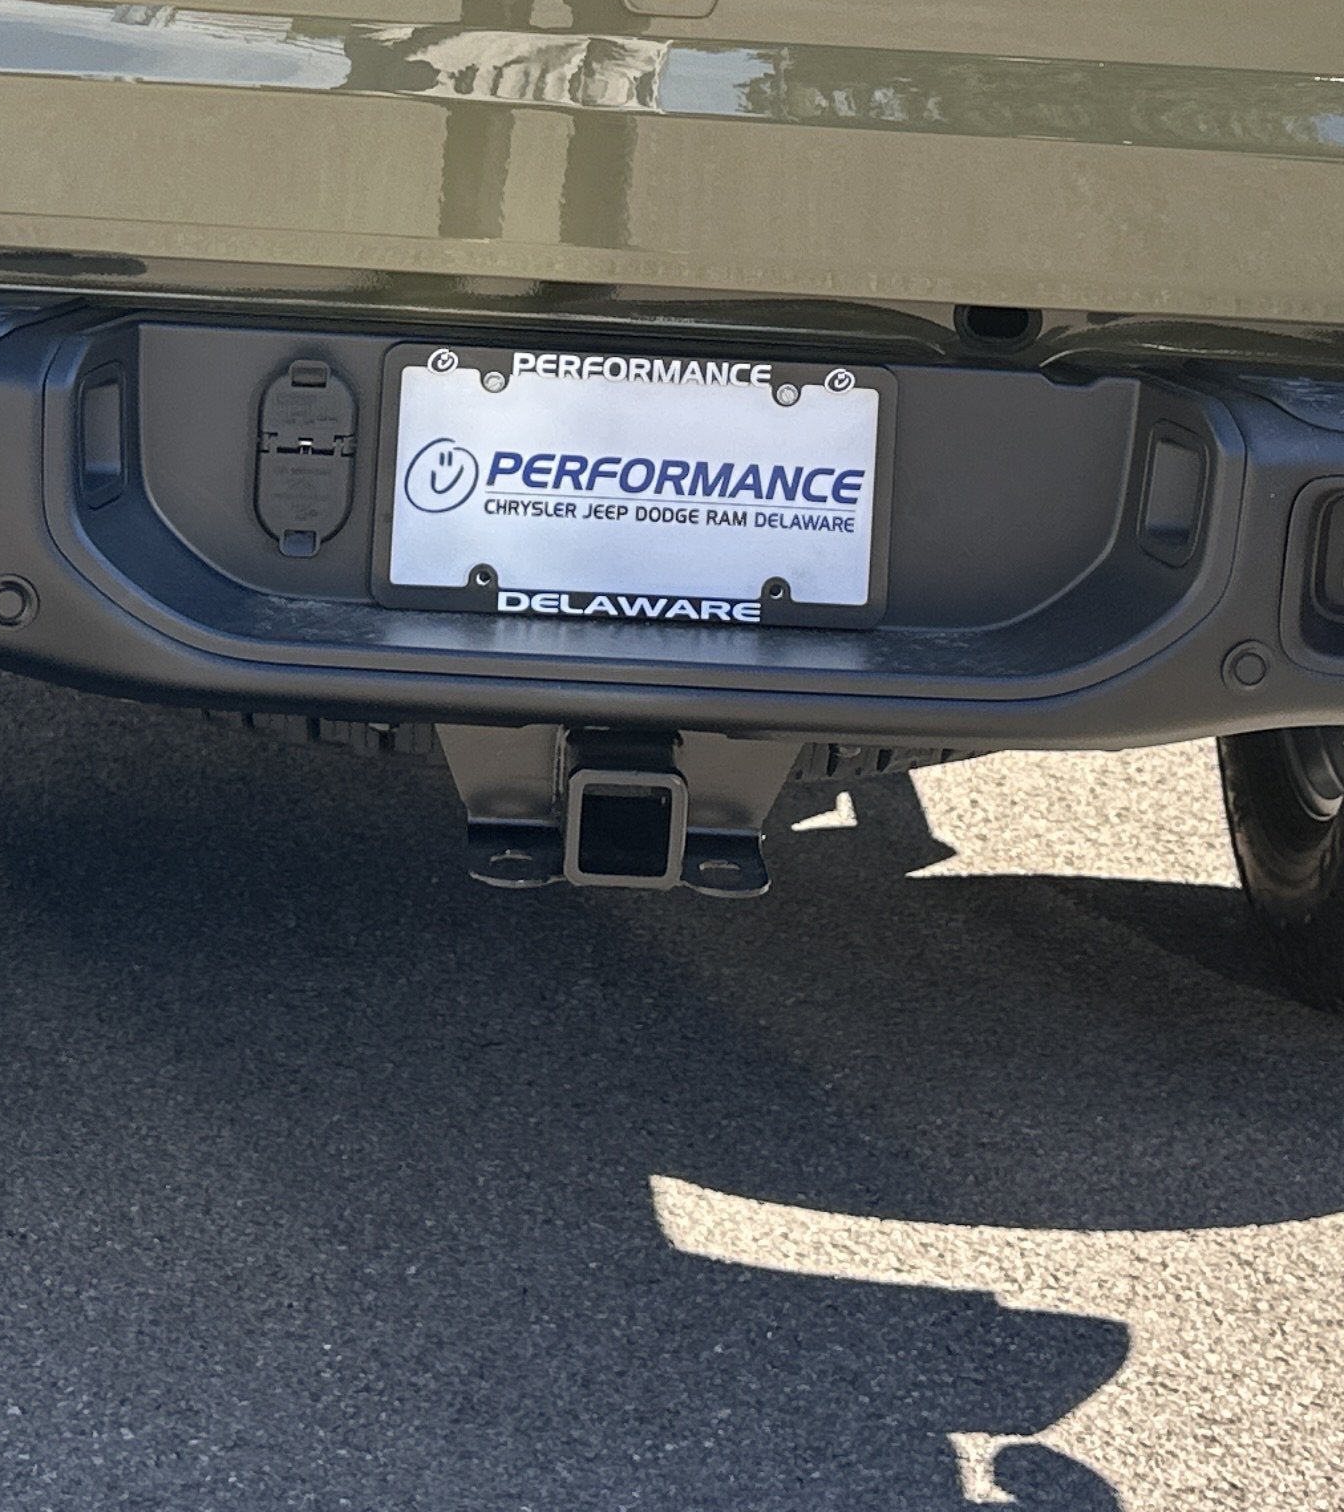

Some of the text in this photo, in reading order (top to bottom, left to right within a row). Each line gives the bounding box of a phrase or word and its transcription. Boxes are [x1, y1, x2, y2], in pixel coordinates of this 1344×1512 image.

[512, 352, 772, 387] PERFORMANCE
[486, 451, 866, 504] PERFORMANCE
[484, 498, 856, 533] CHRYSLER JEEP DODGE RAM DELAWARE
[497, 591, 761, 622] DELAWARE
